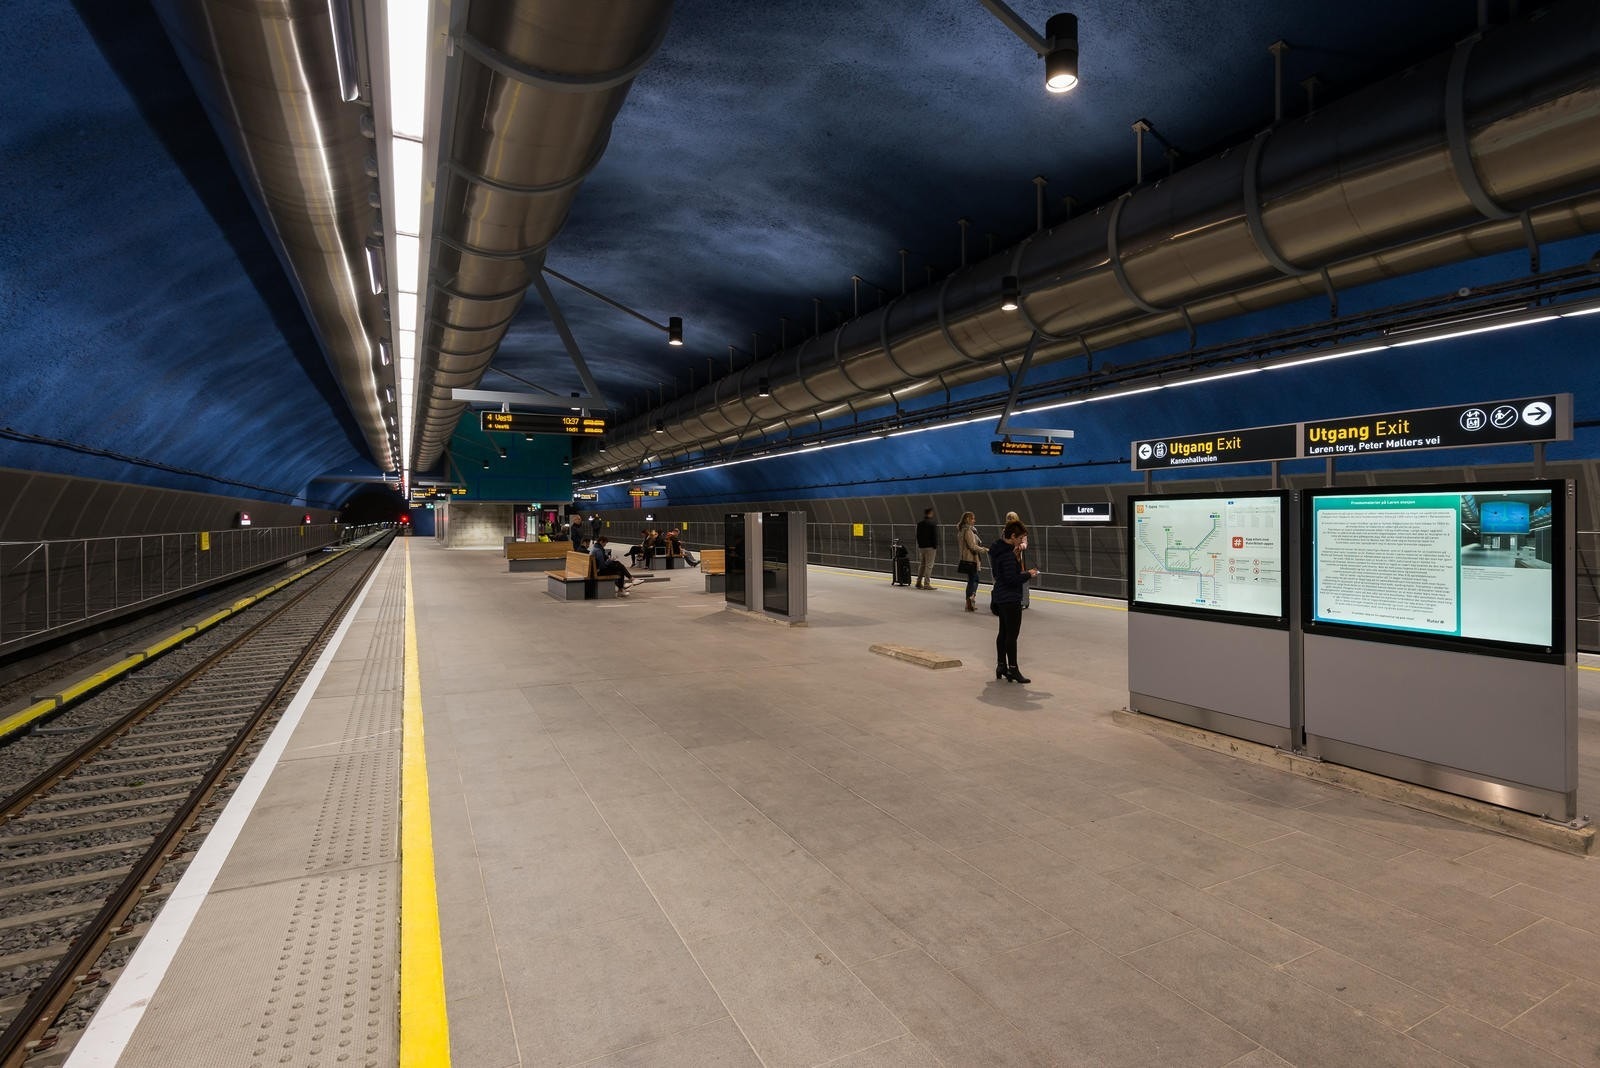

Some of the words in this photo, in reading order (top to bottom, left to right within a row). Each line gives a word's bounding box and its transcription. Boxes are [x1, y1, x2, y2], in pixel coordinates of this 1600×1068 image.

[562, 417, 579, 425] 10:37
[1309, 425, 1370, 444] Utgang
[1376, 419, 1410, 436] Exit
[1169, 441, 1213, 456] Utgang
[1217, 436, 1242, 451] Exit
[1309, 445, 1334, 454] Løren
[1336, 443, 1357, 454] torg,
[1359, 441, 1384, 451] Peter
[1386, 437, 1424, 448] Møllers
[1425, 435, 1441, 445] vei
[1170, 455, 1218, 465] Kanonhallveien
[1077, 506, 1094, 514] Løren
